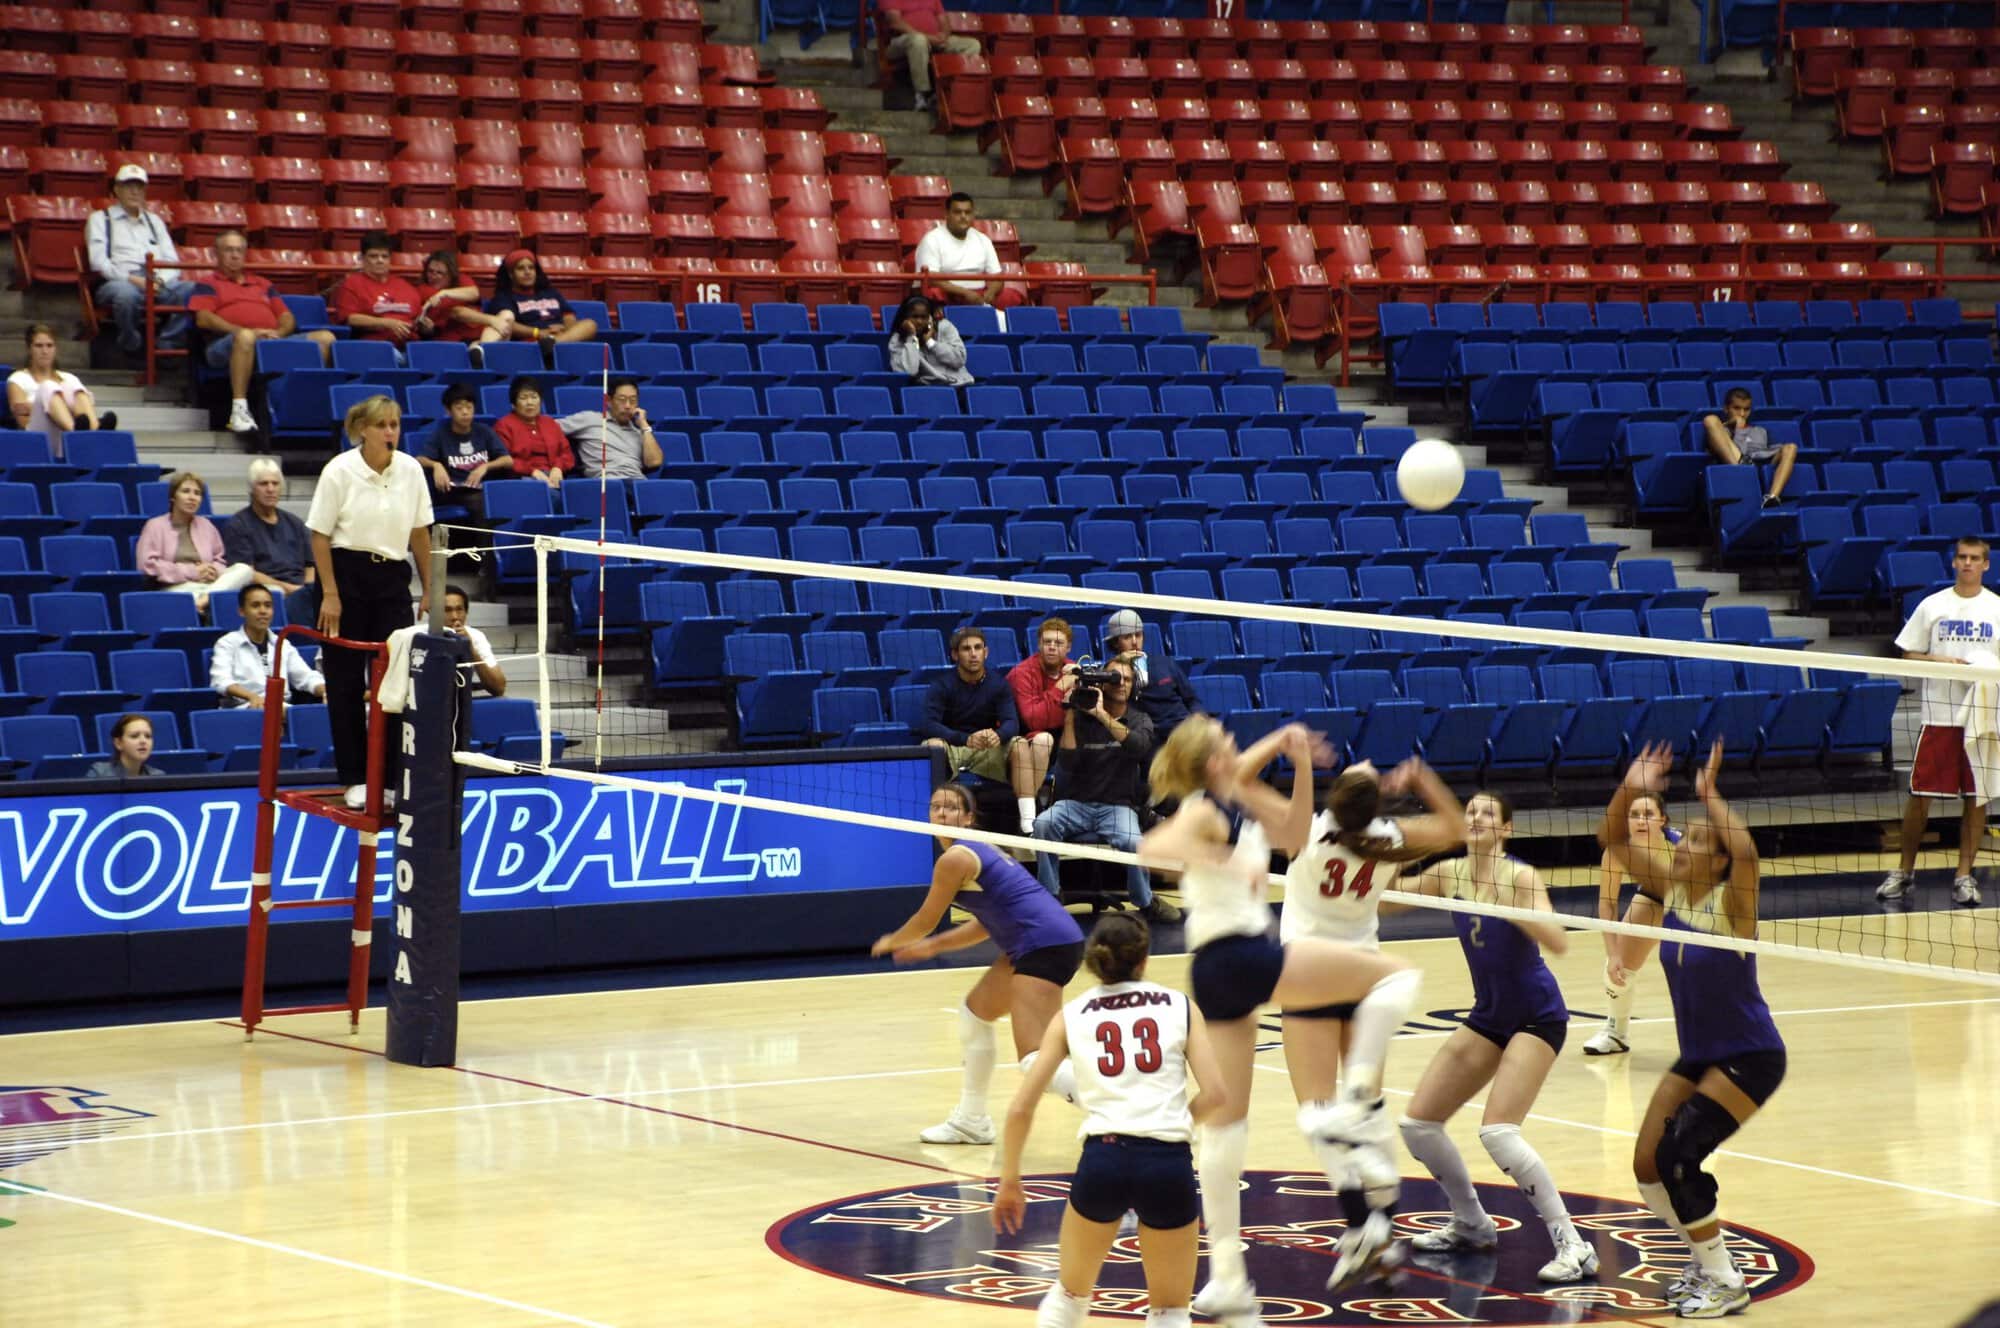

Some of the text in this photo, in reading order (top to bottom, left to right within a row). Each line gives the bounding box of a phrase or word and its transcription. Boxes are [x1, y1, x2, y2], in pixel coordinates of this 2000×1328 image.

[1215, 0, 1233, 19] 17
[696, 283, 722, 304] 16
[1712, 287, 1732, 303] 17
[764, 849, 800, 875] TM
[1319, 857, 1378, 899] 34
[1080, 990, 1172, 1014] ARIZONA
[1095, 1017, 1163, 1078] 33
